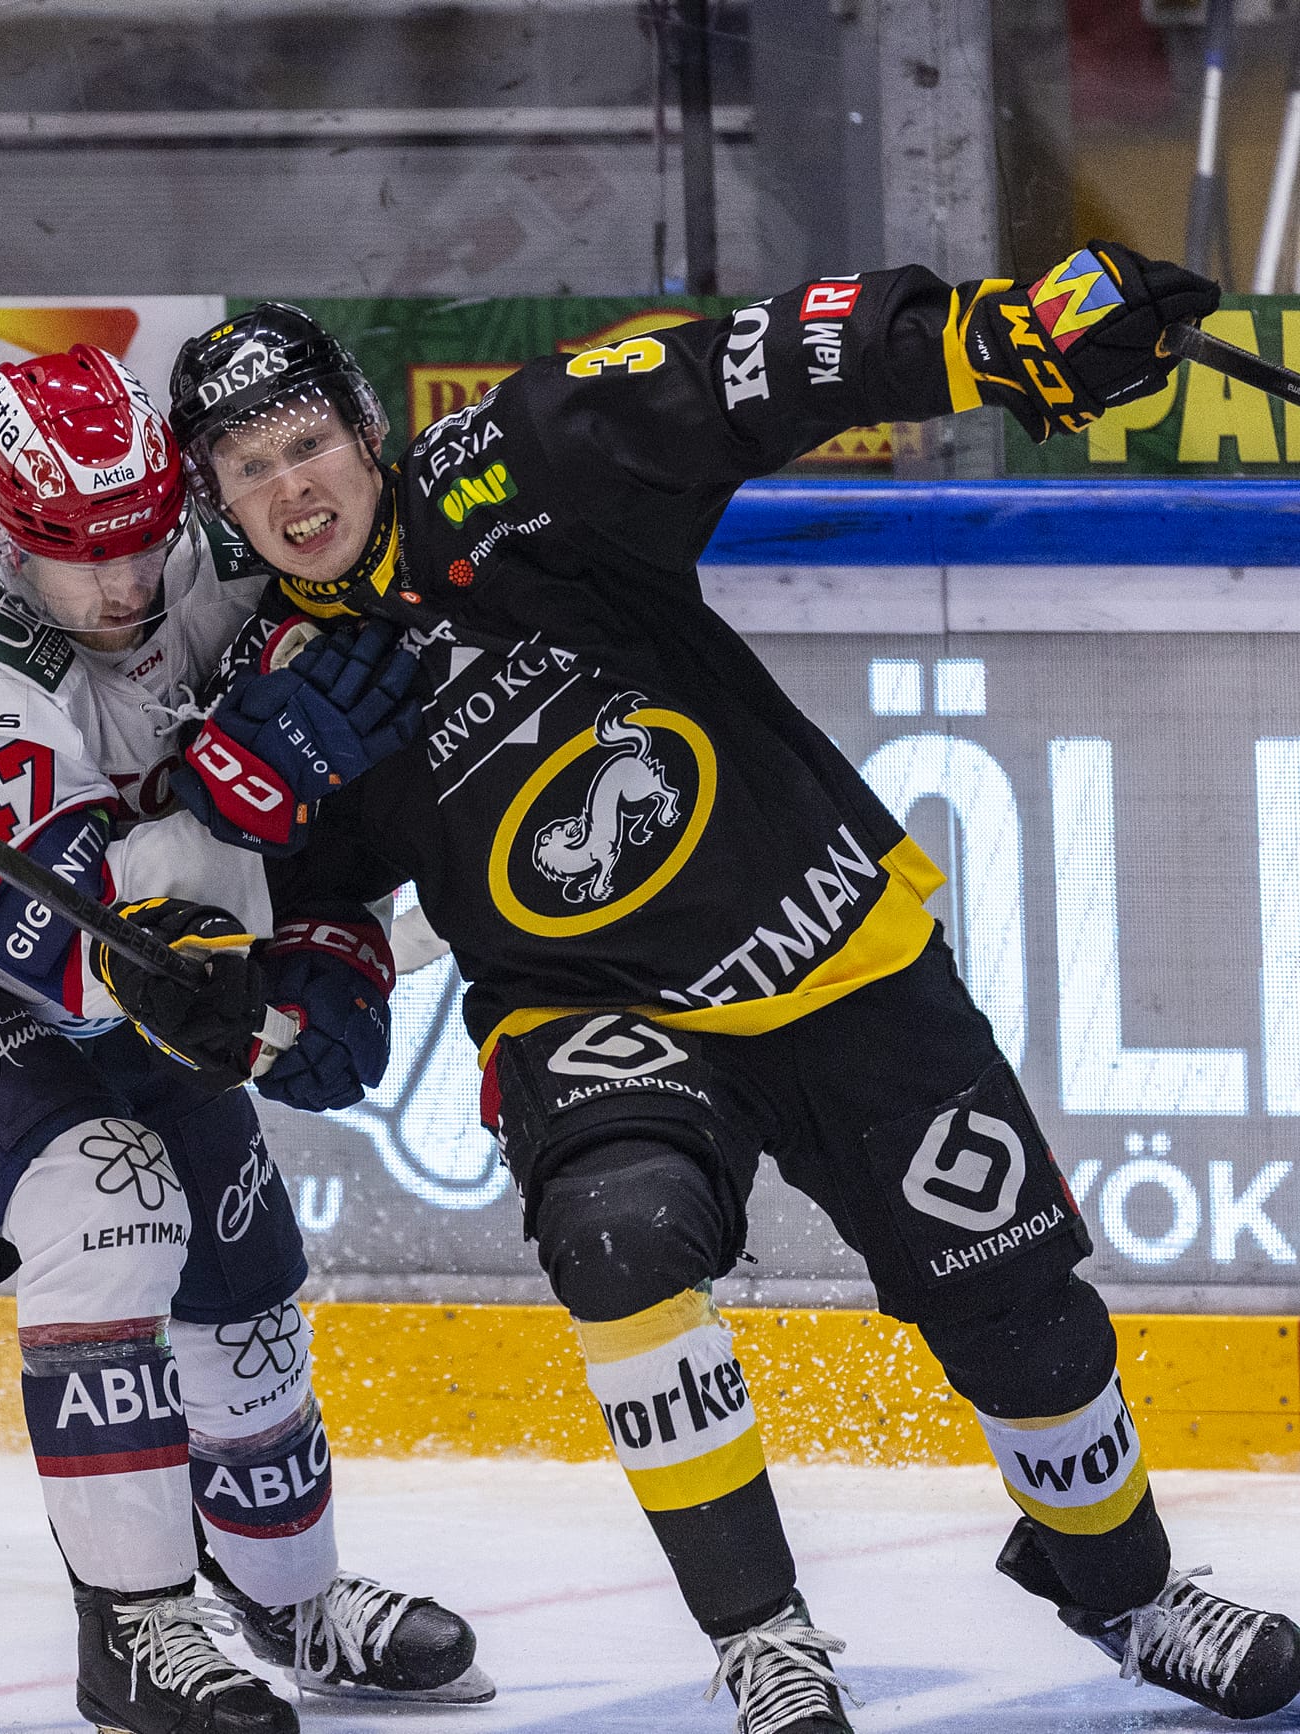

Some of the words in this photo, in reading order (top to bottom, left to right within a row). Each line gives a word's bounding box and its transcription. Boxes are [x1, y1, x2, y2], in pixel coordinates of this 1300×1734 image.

[197, 346, 290, 411] DISAS
[722, 297, 774, 411] KO
[92, 465, 136, 490] Aktia
[87, 507, 153, 535] CCM
[555, 1076, 713, 1109] LÄHITAPIOLA
[929, 1203, 1066, 1278] LÄHITAPIOLA
